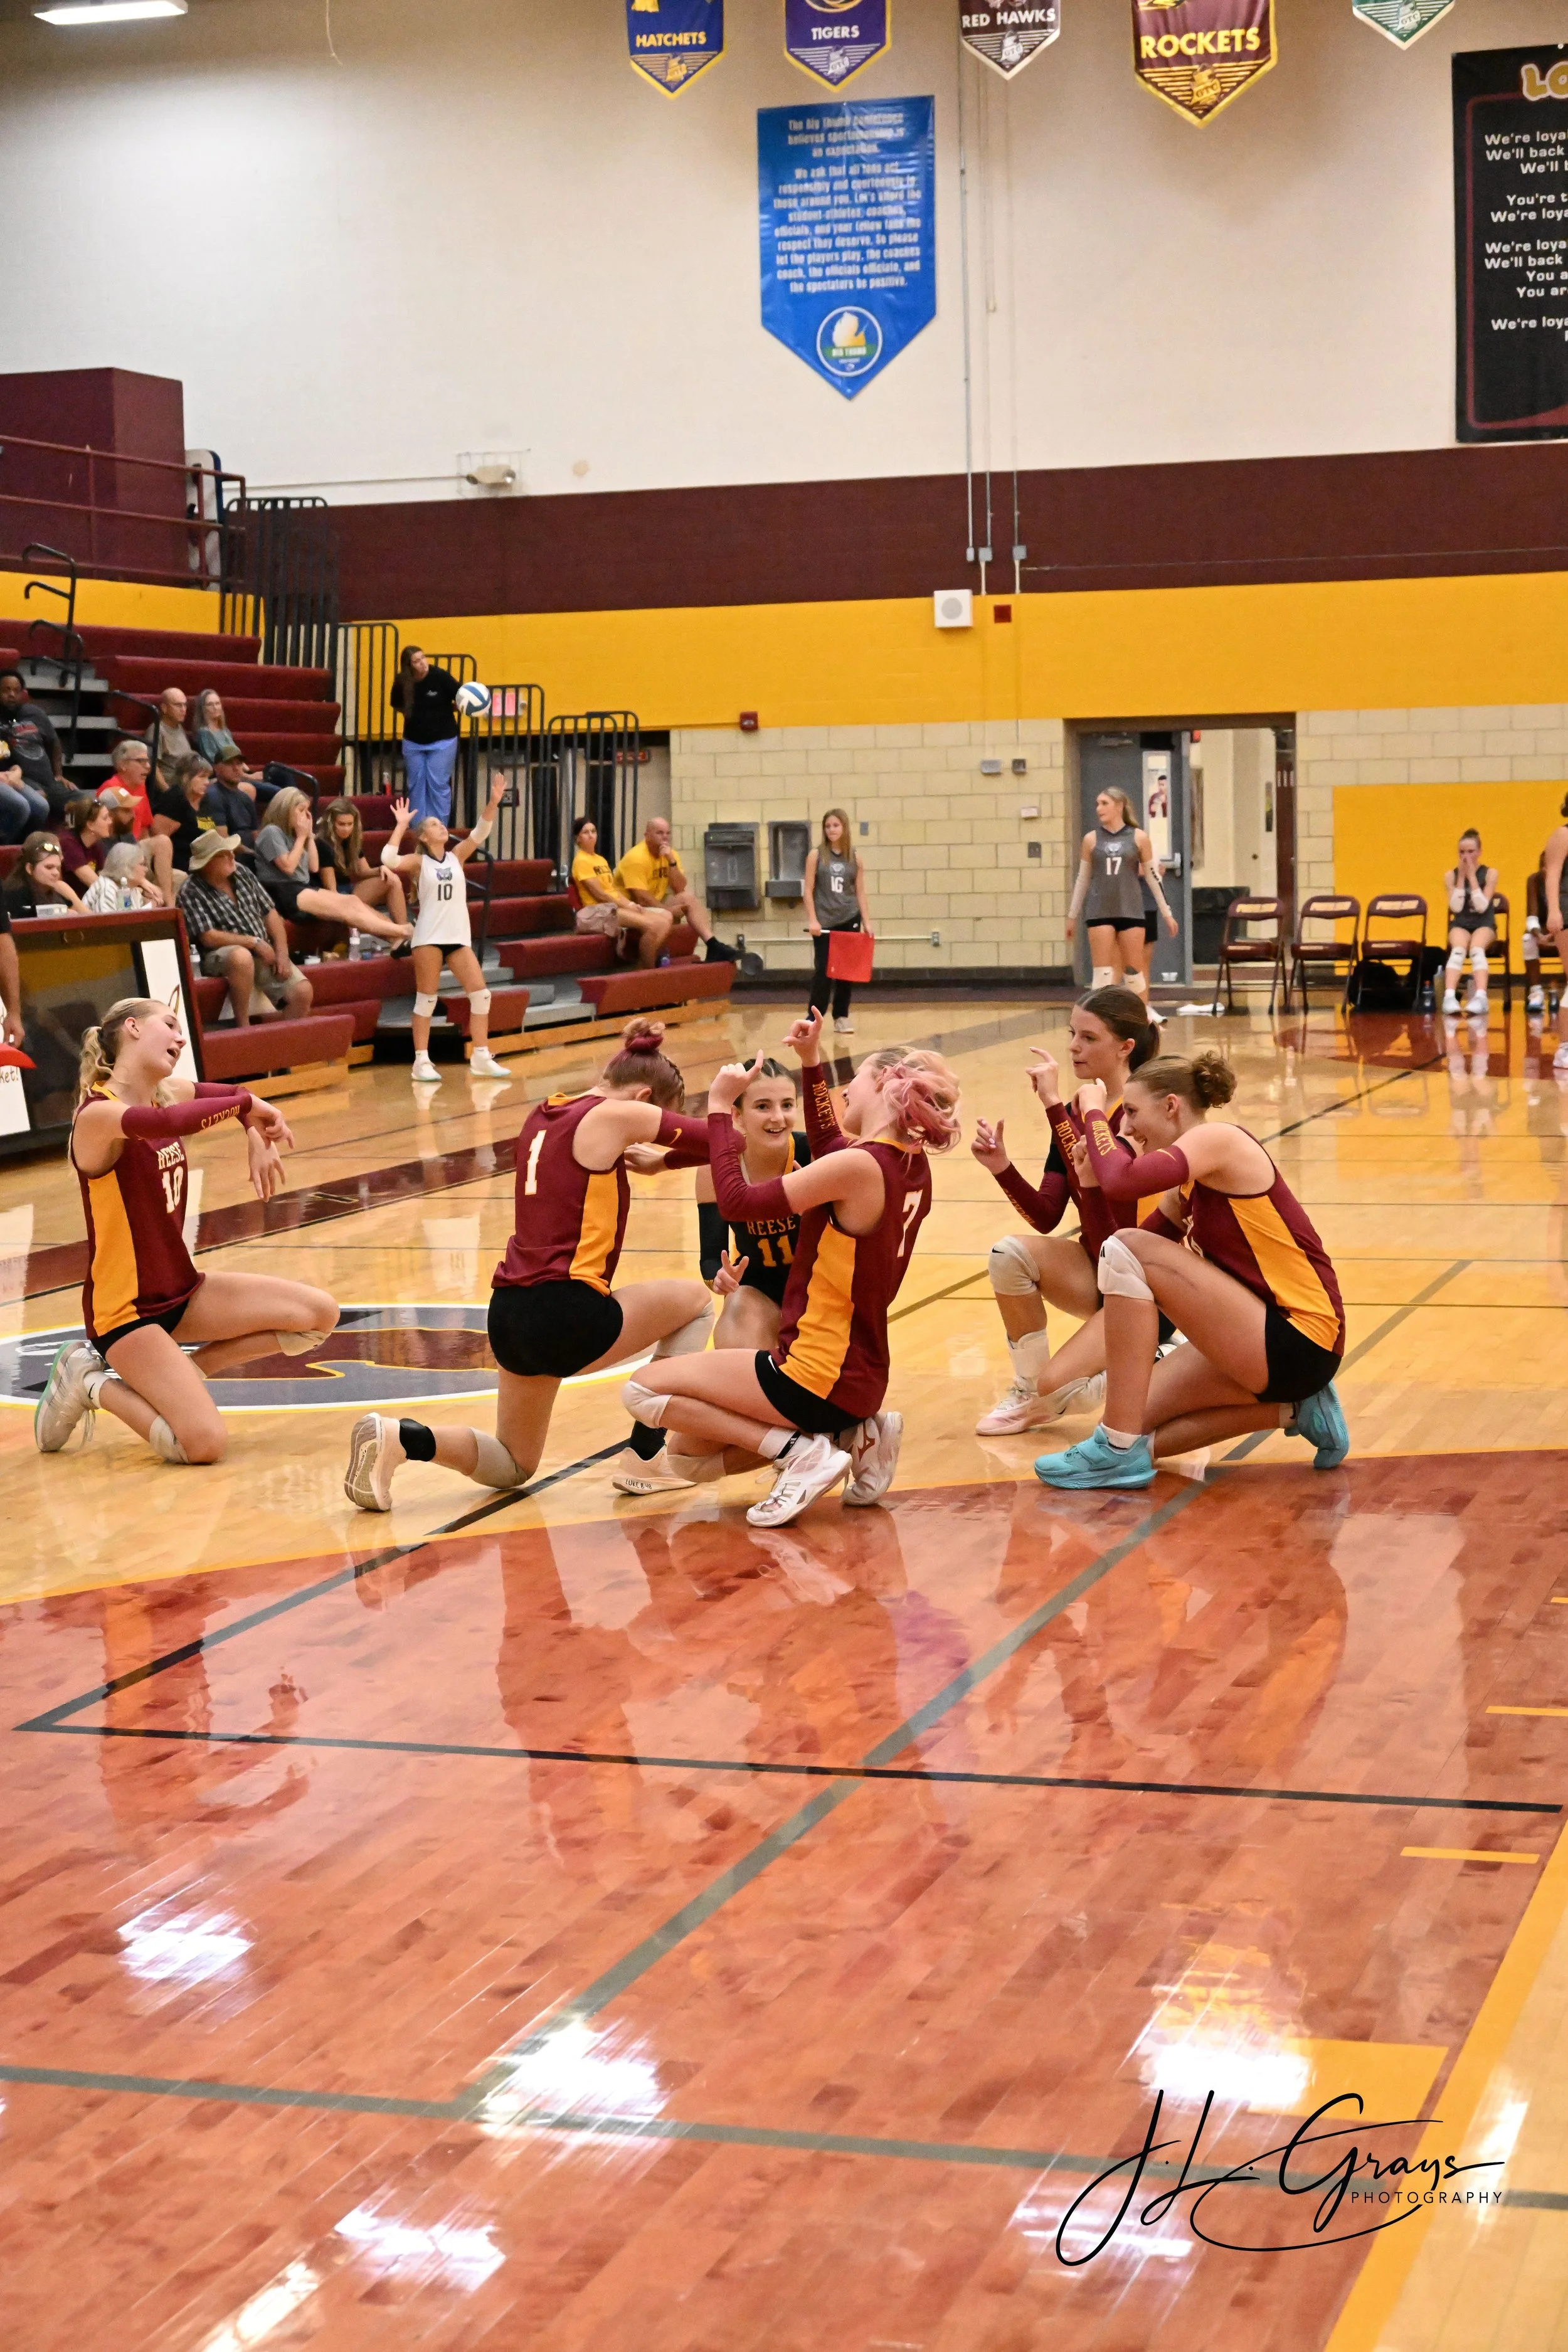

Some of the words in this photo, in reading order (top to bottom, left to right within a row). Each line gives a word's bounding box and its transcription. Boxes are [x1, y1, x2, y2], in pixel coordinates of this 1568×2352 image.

[962, 14, 990, 28] RED
[997, 8, 1055, 24] HAWKS
[636, 32, 707, 47] HATCHETS
[811, 25, 859, 40] TIGERS
[1141, 28, 1259, 58] ROCKETS
[1195, 82, 1218, 97] GTC
[1485, 133, 1530, 146] We're
[1536, 131, 1568, 144] loya
[1486, 147, 1524, 161] We'll
[1529, 145, 1565, 158] back
[1520, 161, 1559, 174] We'll
[1506, 193, 1555, 206] You're
[1490, 209, 1537, 223] We're
[1485, 241, 1531, 254] We're
[1536, 239, 1568, 252] loya
[1484, 257, 1523, 269] We'll
[1528, 254, 1563, 267] back
[1526, 270, 1554, 282] You
[1516, 287, 1545, 298] You
[1550, 287, 1568, 296] ar
[1491, 318, 1537, 331] We're
[1106, 857, 1122, 875] 17
[438, 883, 453, 901] 10
[1092, 1120, 1117, 1156] ROCKETS
[157, 1142, 184, 1170] REESE
[524, 1130, 546, 1195] 1
[162, 1166, 184, 1214] 10
[747, 1216, 796, 1235] REESE
[897, 1190, 923, 1258] 7
[758, 1235, 795, 1267] 11
[625, 1479, 639, 1488] LUKE
